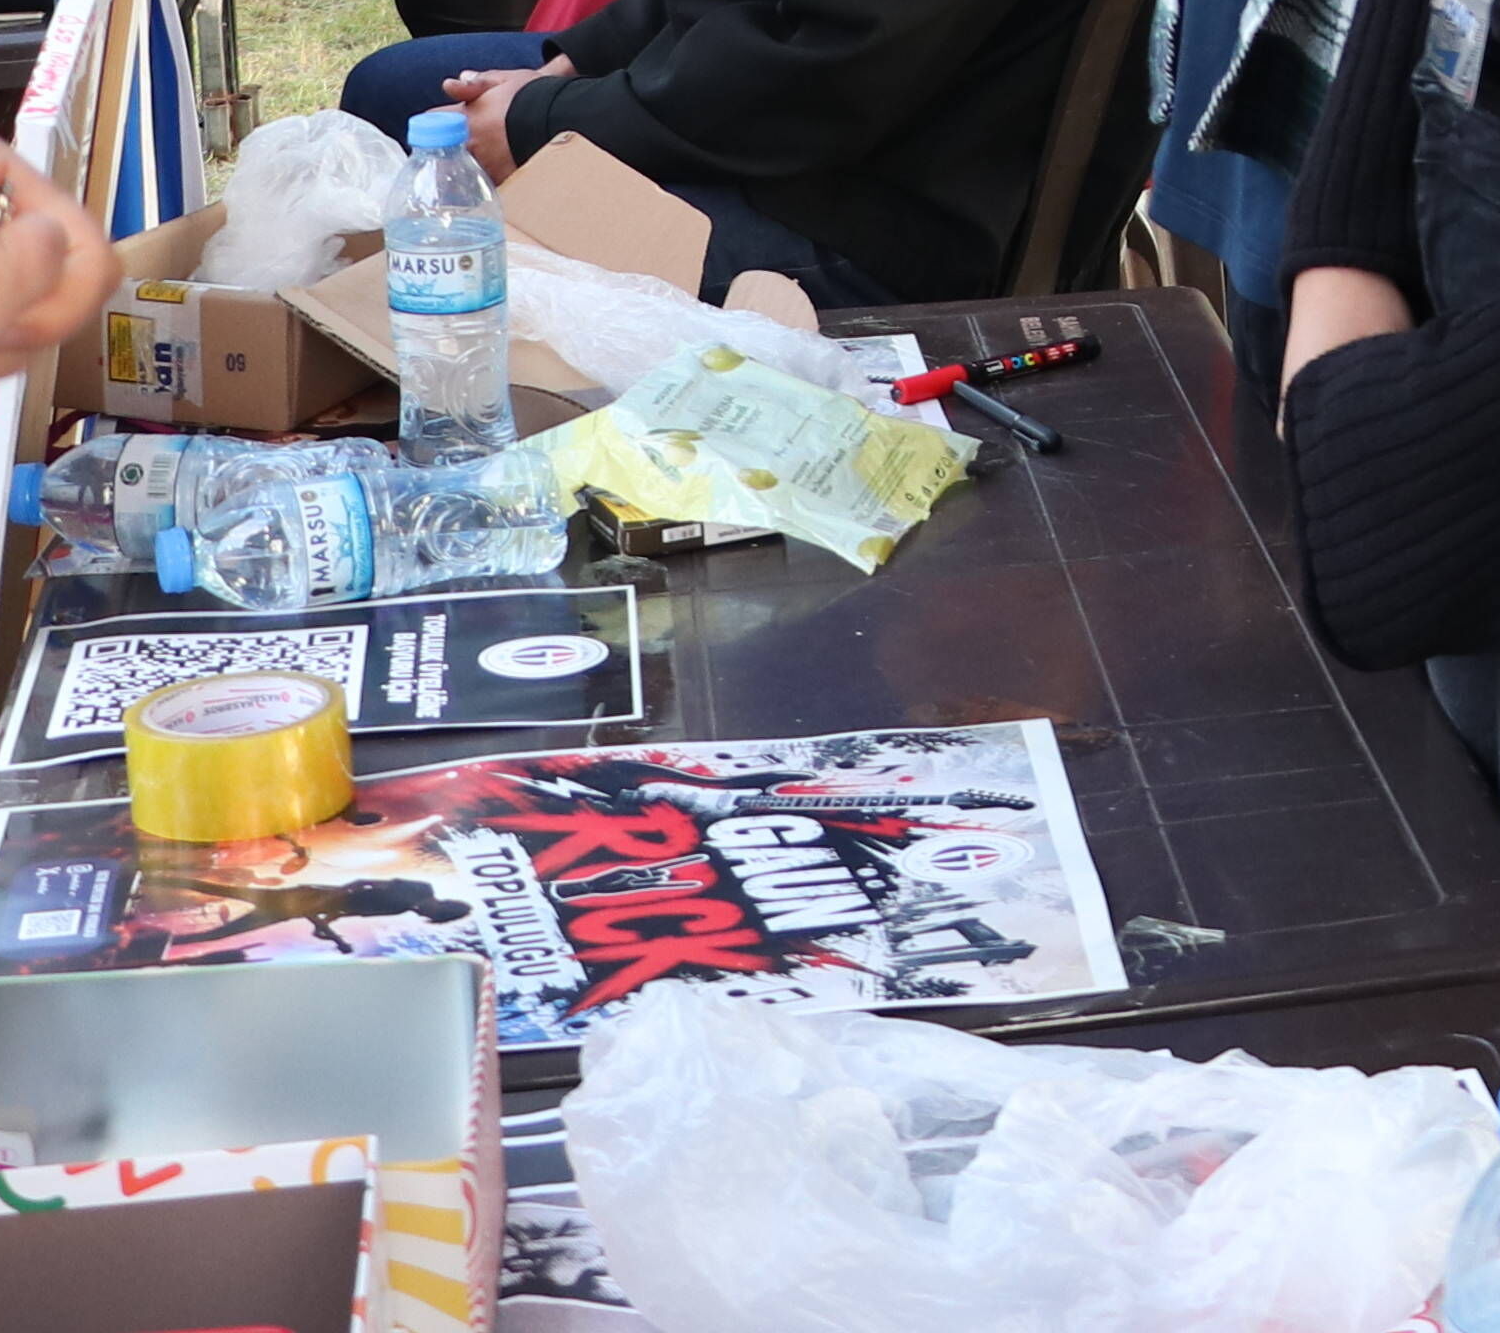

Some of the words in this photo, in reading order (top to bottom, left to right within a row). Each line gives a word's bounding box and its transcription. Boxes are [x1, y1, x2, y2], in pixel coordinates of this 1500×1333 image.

[390, 255, 456, 275] MARSU
[304, 504, 336, 583] MARSU
[385, 632, 417, 678] BAŞVURU
[419, 613, 447, 662] TOPLULUK
[381, 679, 417, 704] İÇİN
[416, 663, 449, 719] ÜYELİĞİNE
[707, 814, 899, 933] GAÜN
[495, 803, 778, 1020] ROCK
